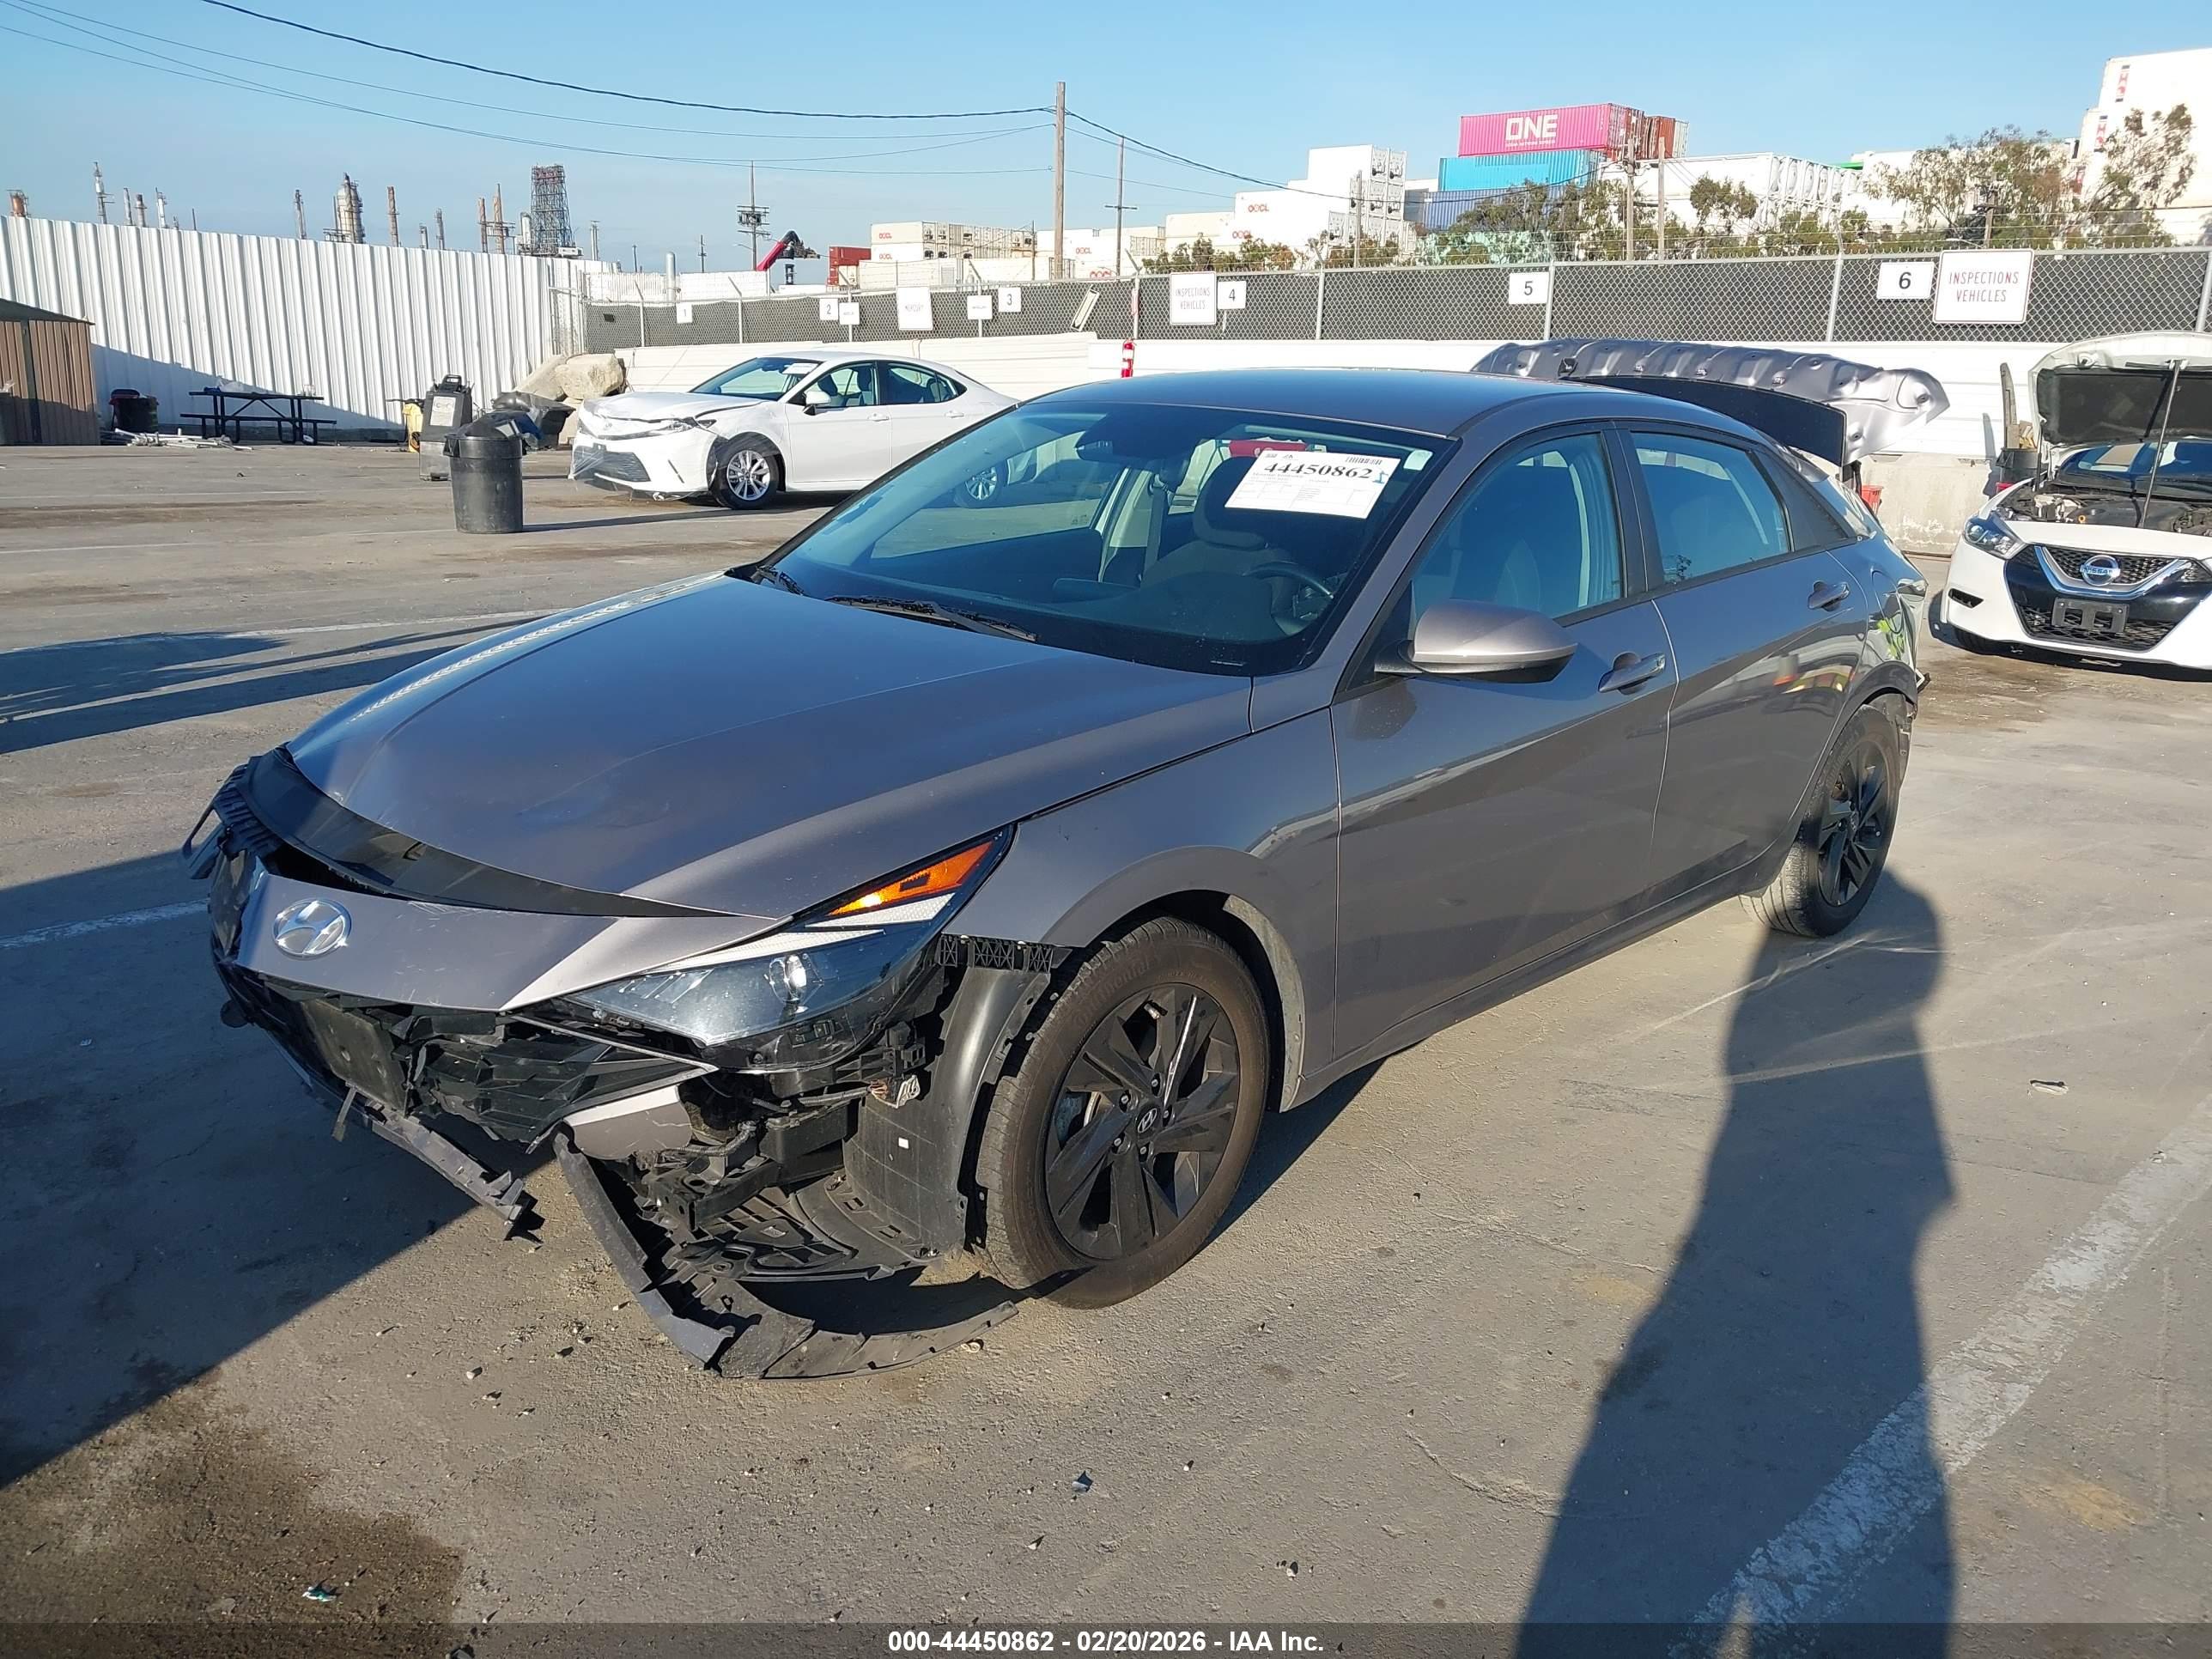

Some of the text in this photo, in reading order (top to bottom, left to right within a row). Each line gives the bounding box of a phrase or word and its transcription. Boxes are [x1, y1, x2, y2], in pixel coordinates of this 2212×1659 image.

[1506, 114, 1559, 140] ONE
[1899, 271, 1912, 289] 6
[1948, 271, 2020, 285] INSPECTIONS
[1175, 287, 1211, 298] INSPECTIONS
[1228, 289, 1237, 301] 4
[1524, 280, 1534, 296] 5
[1006, 294, 1012, 306] 3
[1956, 289, 2008, 303] VEHICLES
[826, 304, 831, 315] 2
[1180, 301, 1206, 310] VEHICLES
[1264, 462, 1373, 479] 44450862
